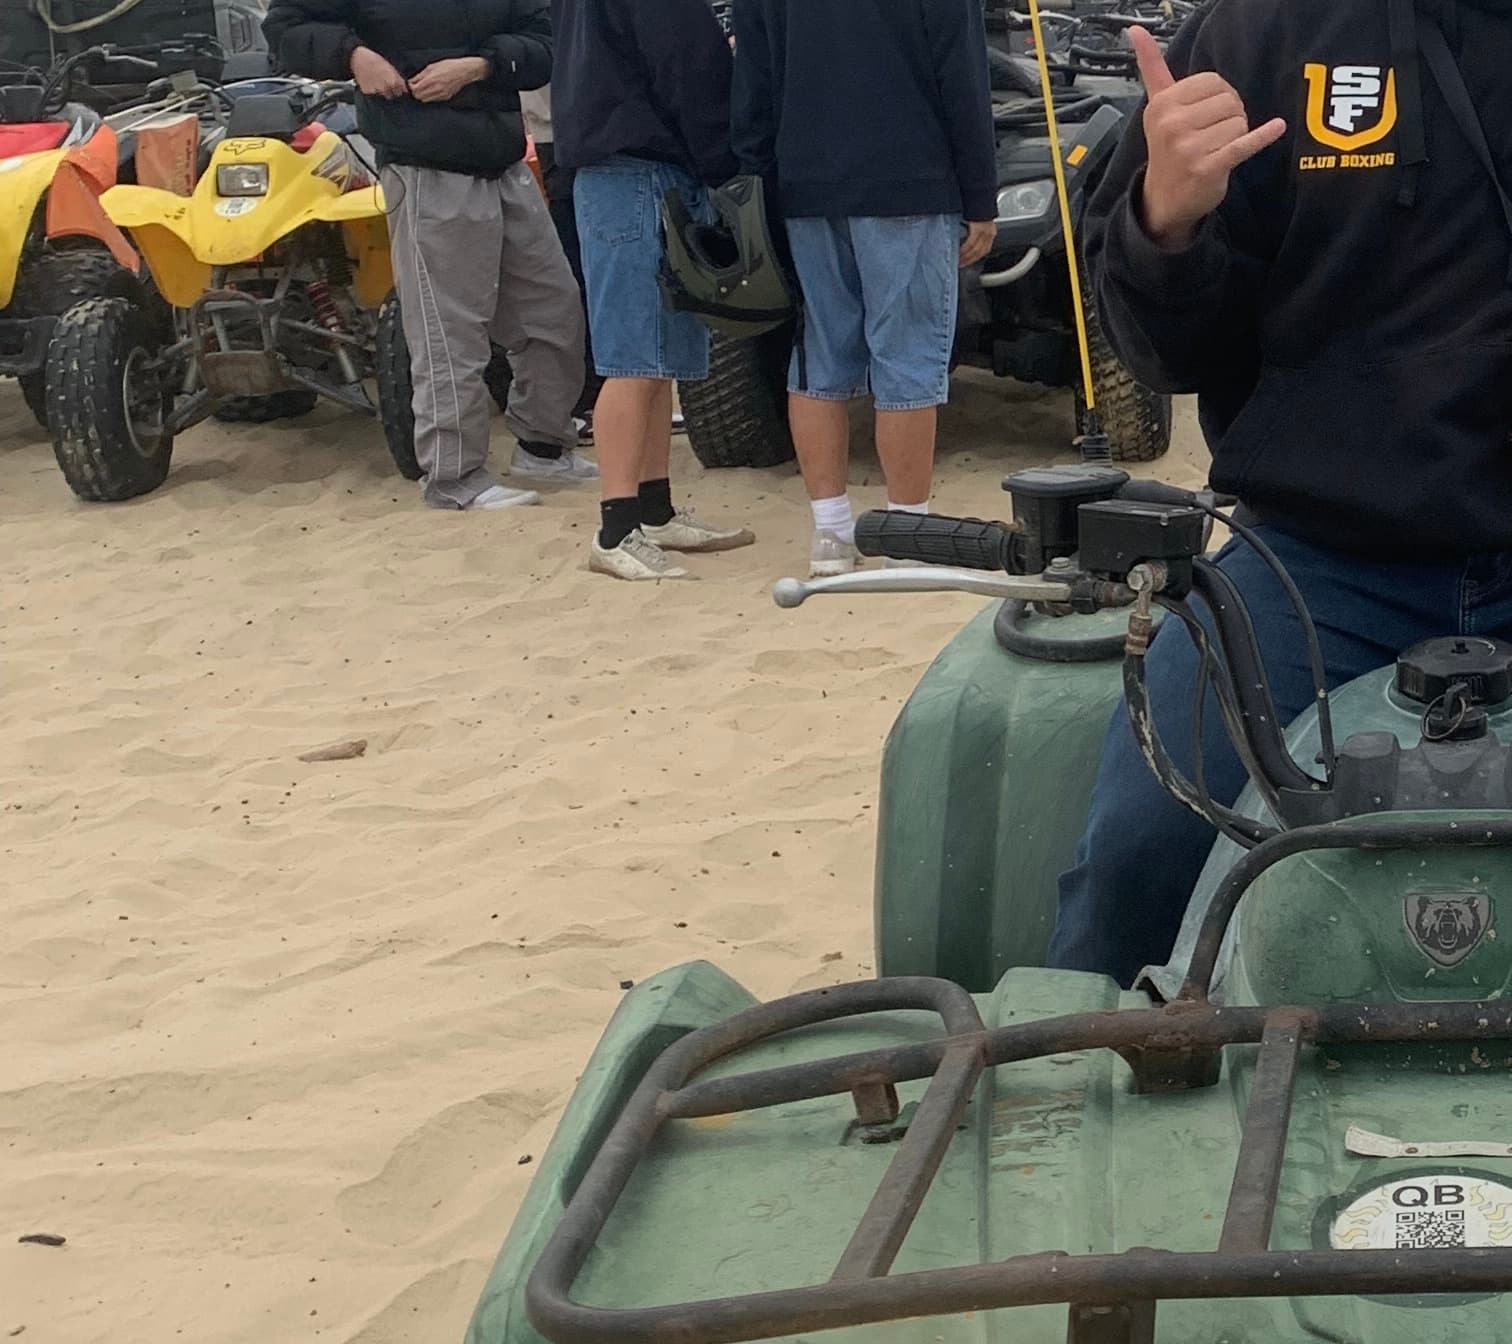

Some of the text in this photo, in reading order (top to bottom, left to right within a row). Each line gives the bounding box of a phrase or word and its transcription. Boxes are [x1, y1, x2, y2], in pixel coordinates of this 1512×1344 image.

[1300, 152, 1395, 170] CLUB BOXING
[1391, 1184, 1466, 1208] QB
